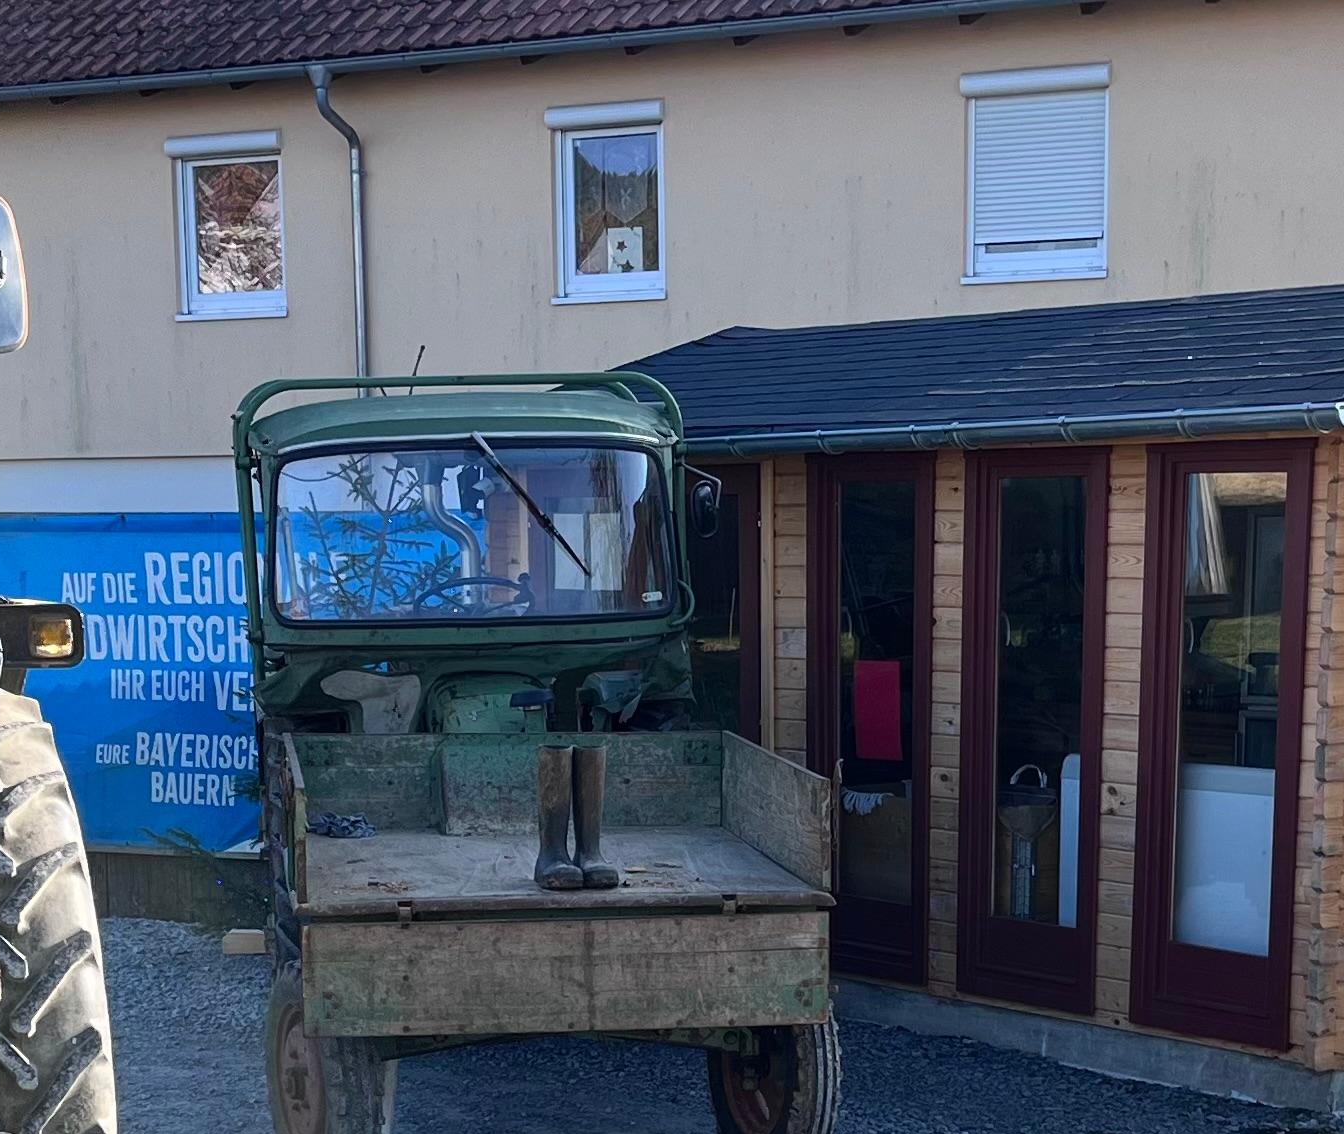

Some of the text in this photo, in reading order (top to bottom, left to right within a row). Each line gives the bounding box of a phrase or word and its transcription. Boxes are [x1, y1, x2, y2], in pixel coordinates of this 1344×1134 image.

[61, 572, 97, 603] AUF
[102, 572, 137, 603] DIE
[110, 668, 146, 700] IHR
[151, 670, 205, 702] EUCH
[95, 743, 130, 765] EURE
[150, 771, 236, 807] BAUERN
